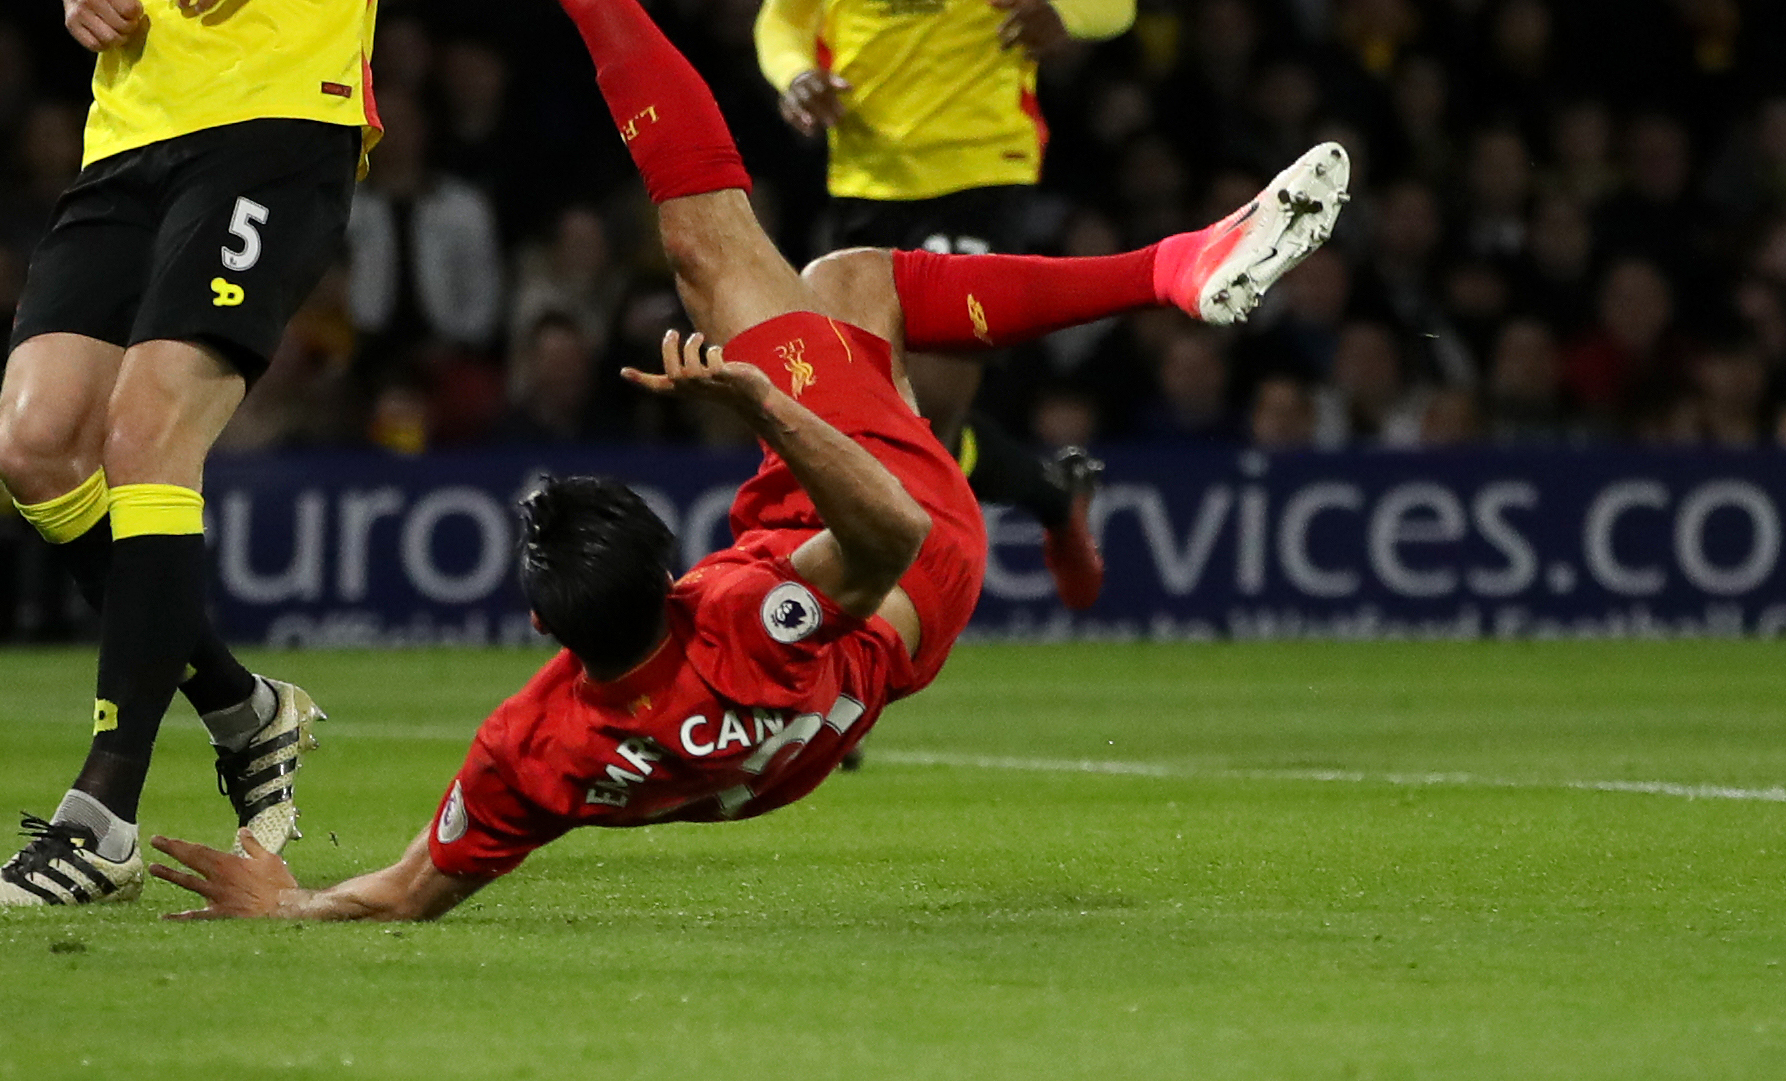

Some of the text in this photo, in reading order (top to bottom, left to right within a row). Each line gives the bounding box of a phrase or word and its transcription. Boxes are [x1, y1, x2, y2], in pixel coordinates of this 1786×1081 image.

[220, 196, 270, 272] 5
[585, 736, 663, 809] EMR
[679, 706, 785, 757] CAN
